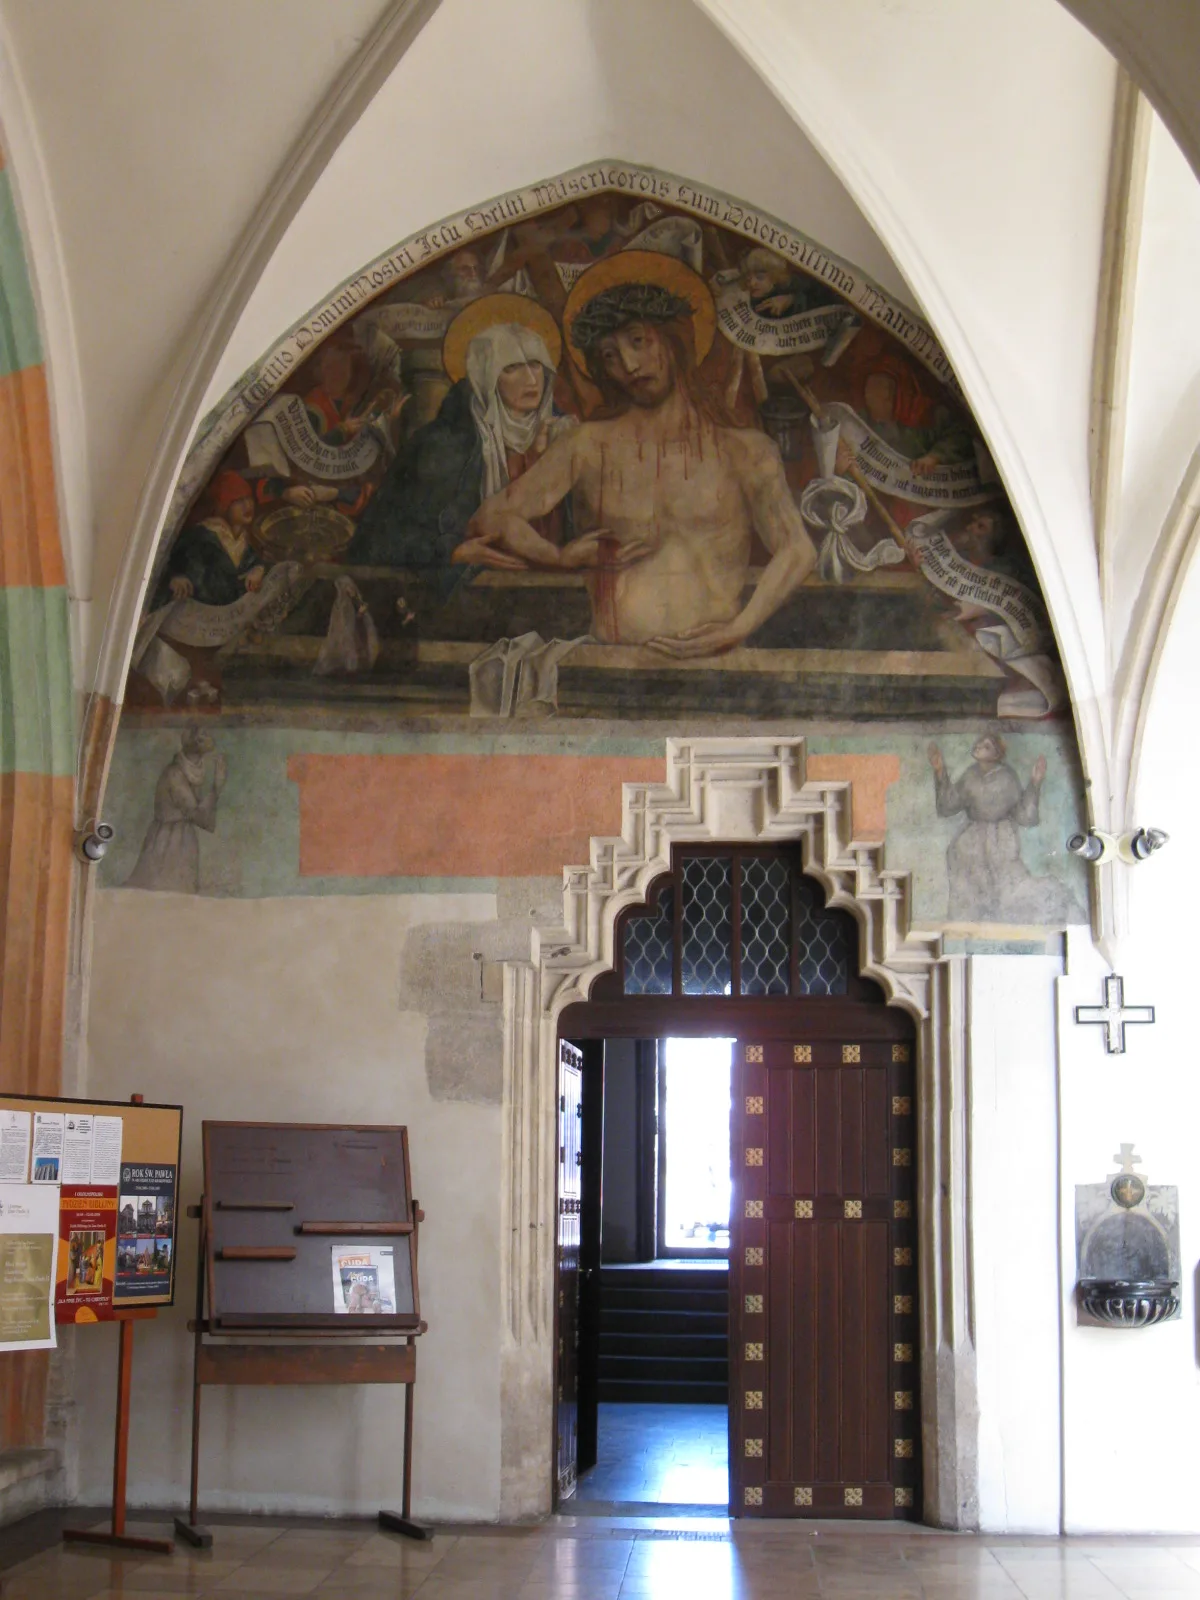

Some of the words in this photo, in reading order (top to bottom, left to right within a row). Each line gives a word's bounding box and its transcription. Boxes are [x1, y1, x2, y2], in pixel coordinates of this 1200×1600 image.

[352, 247, 415, 299] Nostri
[131, 1168, 144, 1178] ROK
[155, 1169, 173, 1179] PAWŁA
